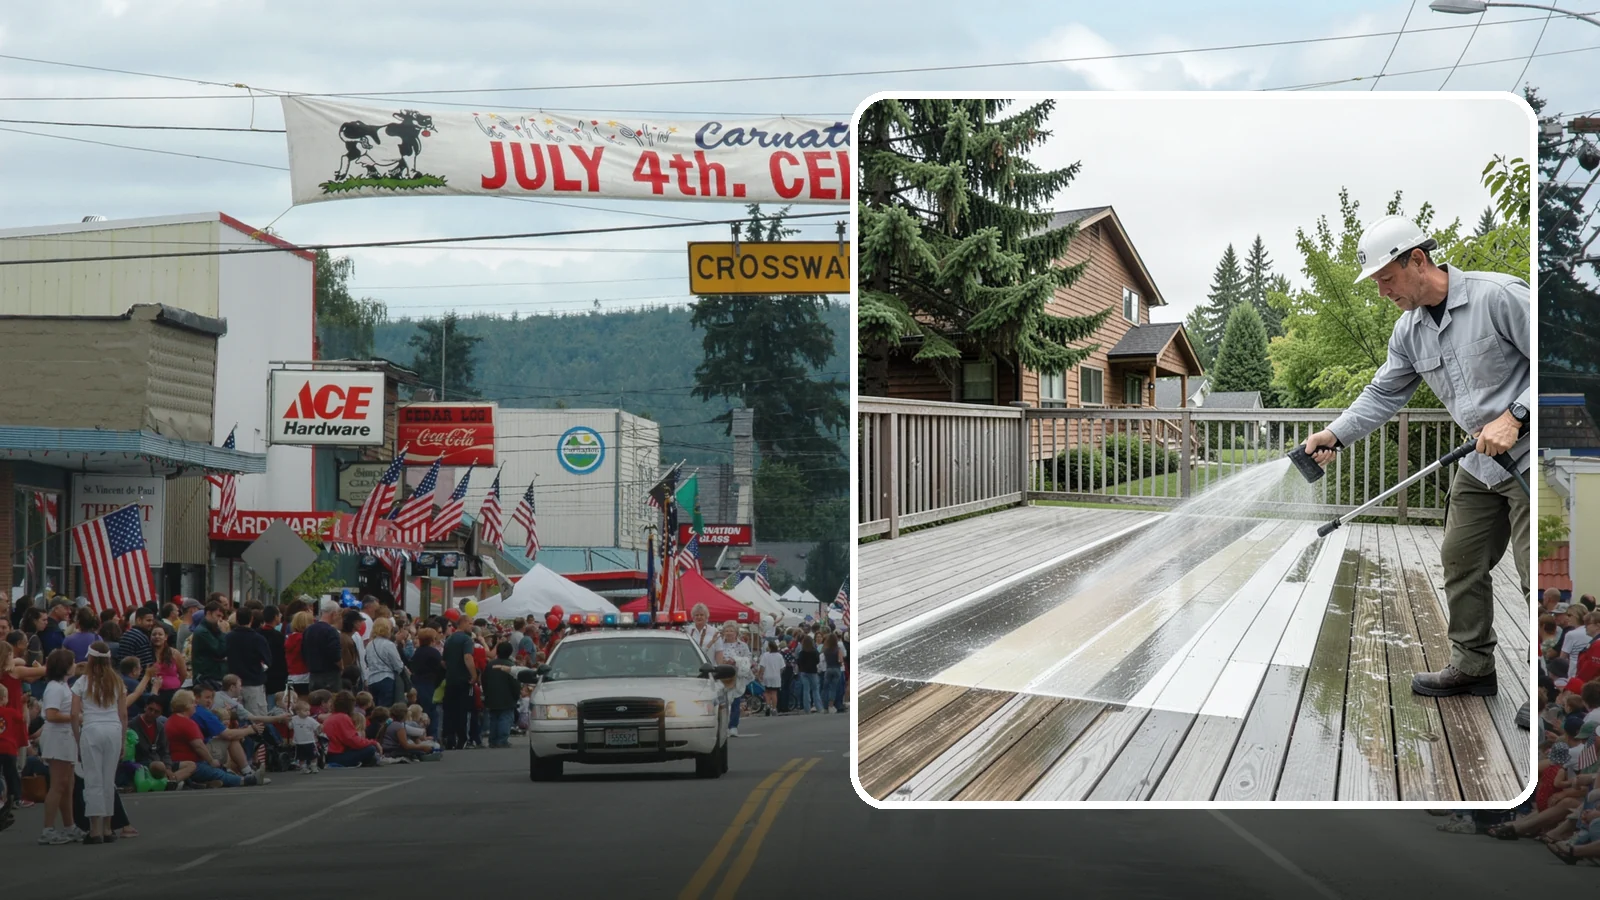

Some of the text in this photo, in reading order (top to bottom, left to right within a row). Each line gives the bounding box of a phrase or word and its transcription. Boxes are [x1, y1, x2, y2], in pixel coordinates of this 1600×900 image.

[481, 141, 605, 192] JULY
[632, 150, 747, 197] 4th.
[697, 254, 850, 280] CROSSWA
[282, 380, 373, 420] ACE
[406, 409, 452, 421] CEDAR
[283, 421, 371, 436] Hardware
[416, 428, 477, 447] Coca-Cola
[354, 467, 384, 480] Simpl
[83, 485, 155, 495] St. Vincent de Paul
[81, 503, 154, 522] THT
[688, 526, 741, 535] CRNATION
[699, 535, 730, 543] GLASS
